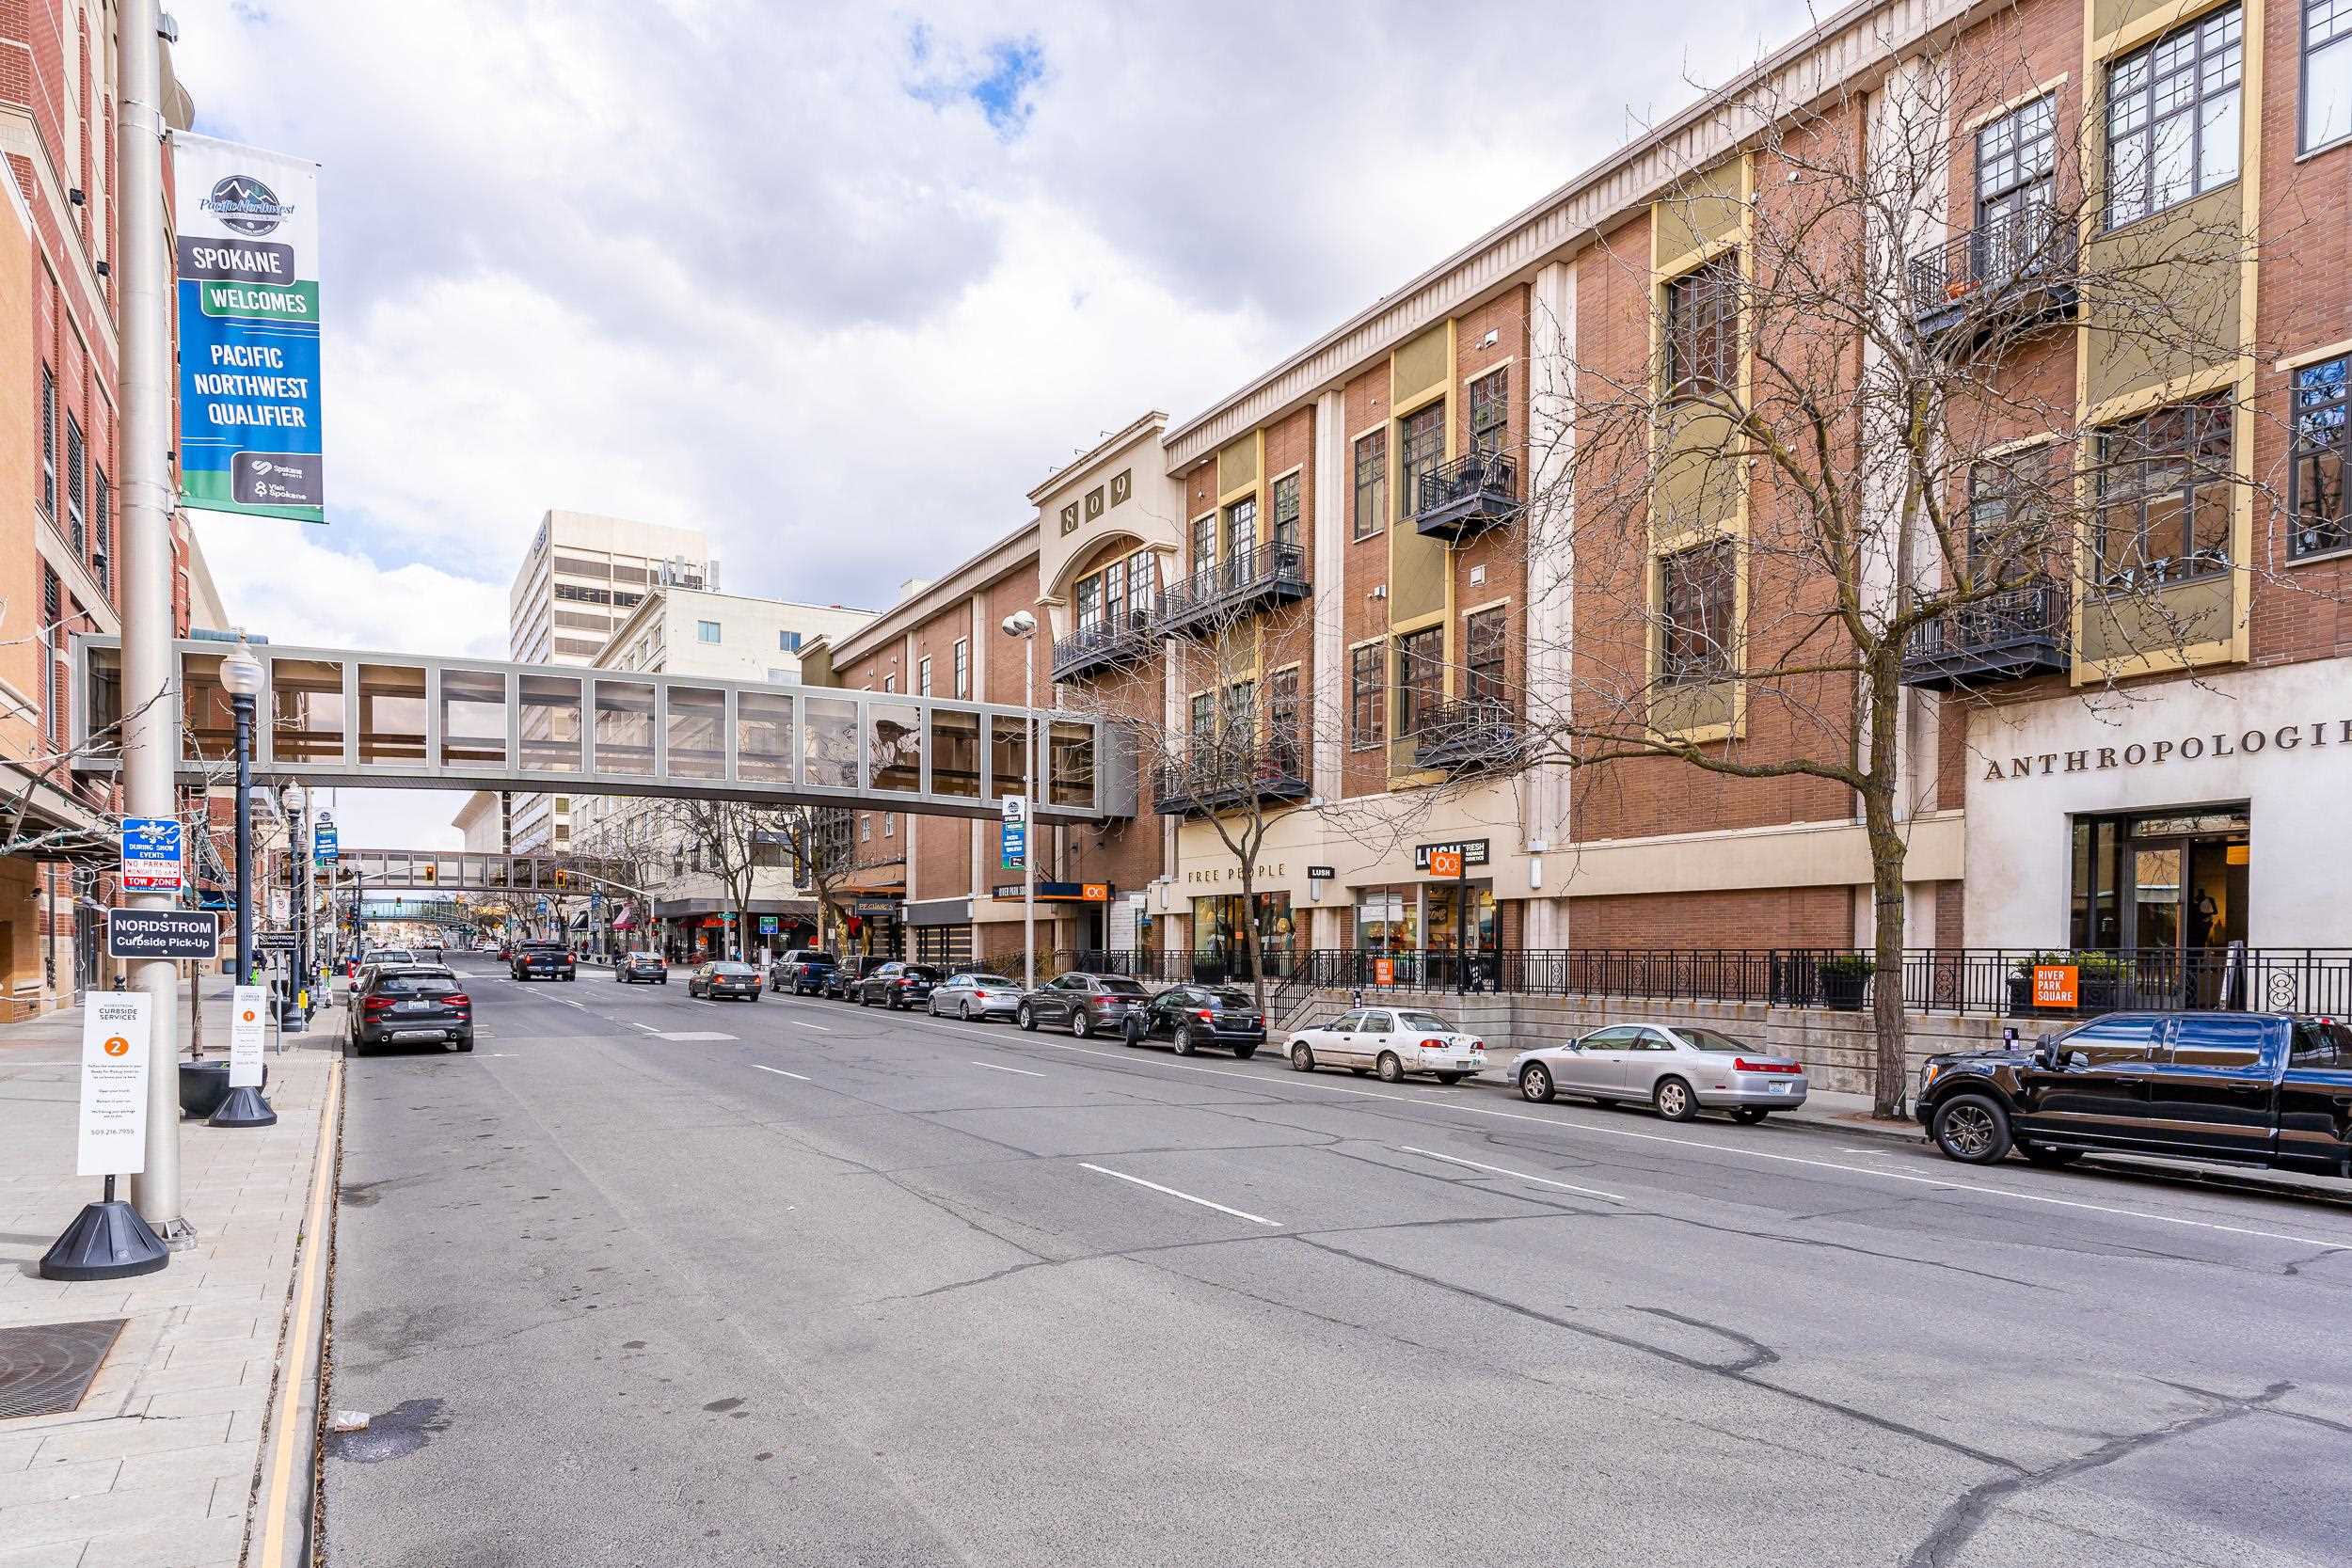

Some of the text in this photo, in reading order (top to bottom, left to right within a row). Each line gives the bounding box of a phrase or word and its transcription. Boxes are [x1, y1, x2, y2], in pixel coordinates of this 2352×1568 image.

[192, 246, 283, 274] SPOKANE
[210, 288, 308, 313] WELCOMES
[210, 344, 283, 369] PACIFIC
[194, 373, 309, 399] NORTHWEST
[208, 403, 307, 428] QUALIFIER
[273, 465, 303, 475] Spokane
[268, 483, 285, 491] Visit
[268, 490, 308, 500] Spokane
[129, 843, 175, 852] DURING SNOW
[143, 860, 178, 868] PARKING
[1188, 869, 1219, 883] FREE
[1311, 868, 1330, 877] LUSH
[128, 877, 178, 886] TOW ZONE
[115, 919, 212, 933] NORDSTROM
[117, 936, 210, 949] Curbside Pick-Up
[2038, 970, 2065, 980] RIVER
[2038, 981, 2061, 990] PARK
[2038, 991, 2074, 1002] SQUARE
[111, 1040, 121, 1053] 2
